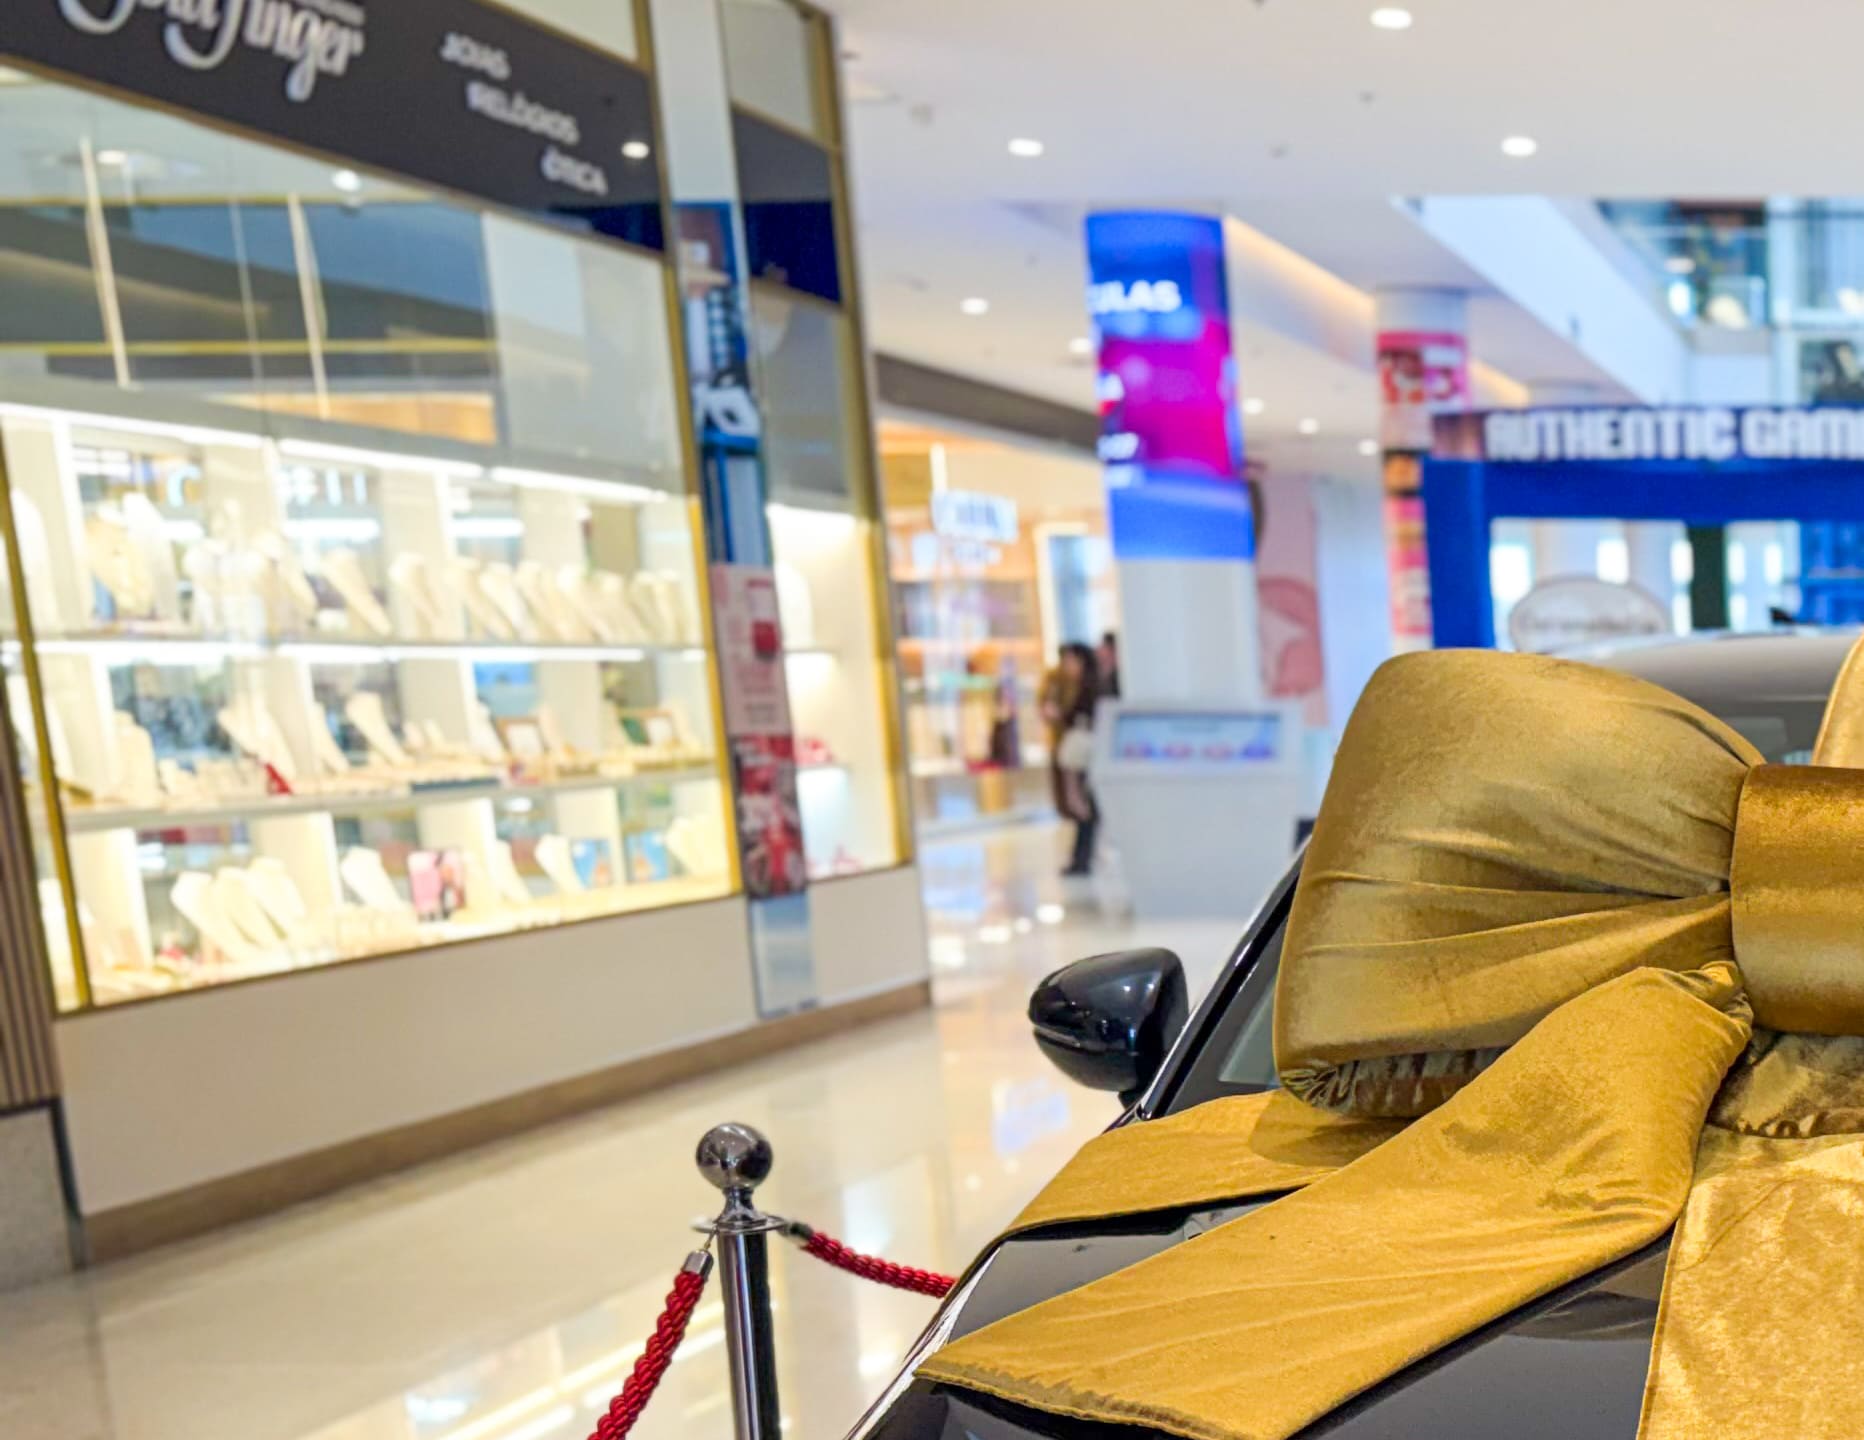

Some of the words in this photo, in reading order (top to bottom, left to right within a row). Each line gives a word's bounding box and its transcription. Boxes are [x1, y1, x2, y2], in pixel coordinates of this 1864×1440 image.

[440, 31, 511, 80] JOIAS
[466, 81, 579, 145] RELÓGIOS
[540, 145, 608, 195] ÓTICA
[1485, 406, 1734, 460] AUTHENTIC
